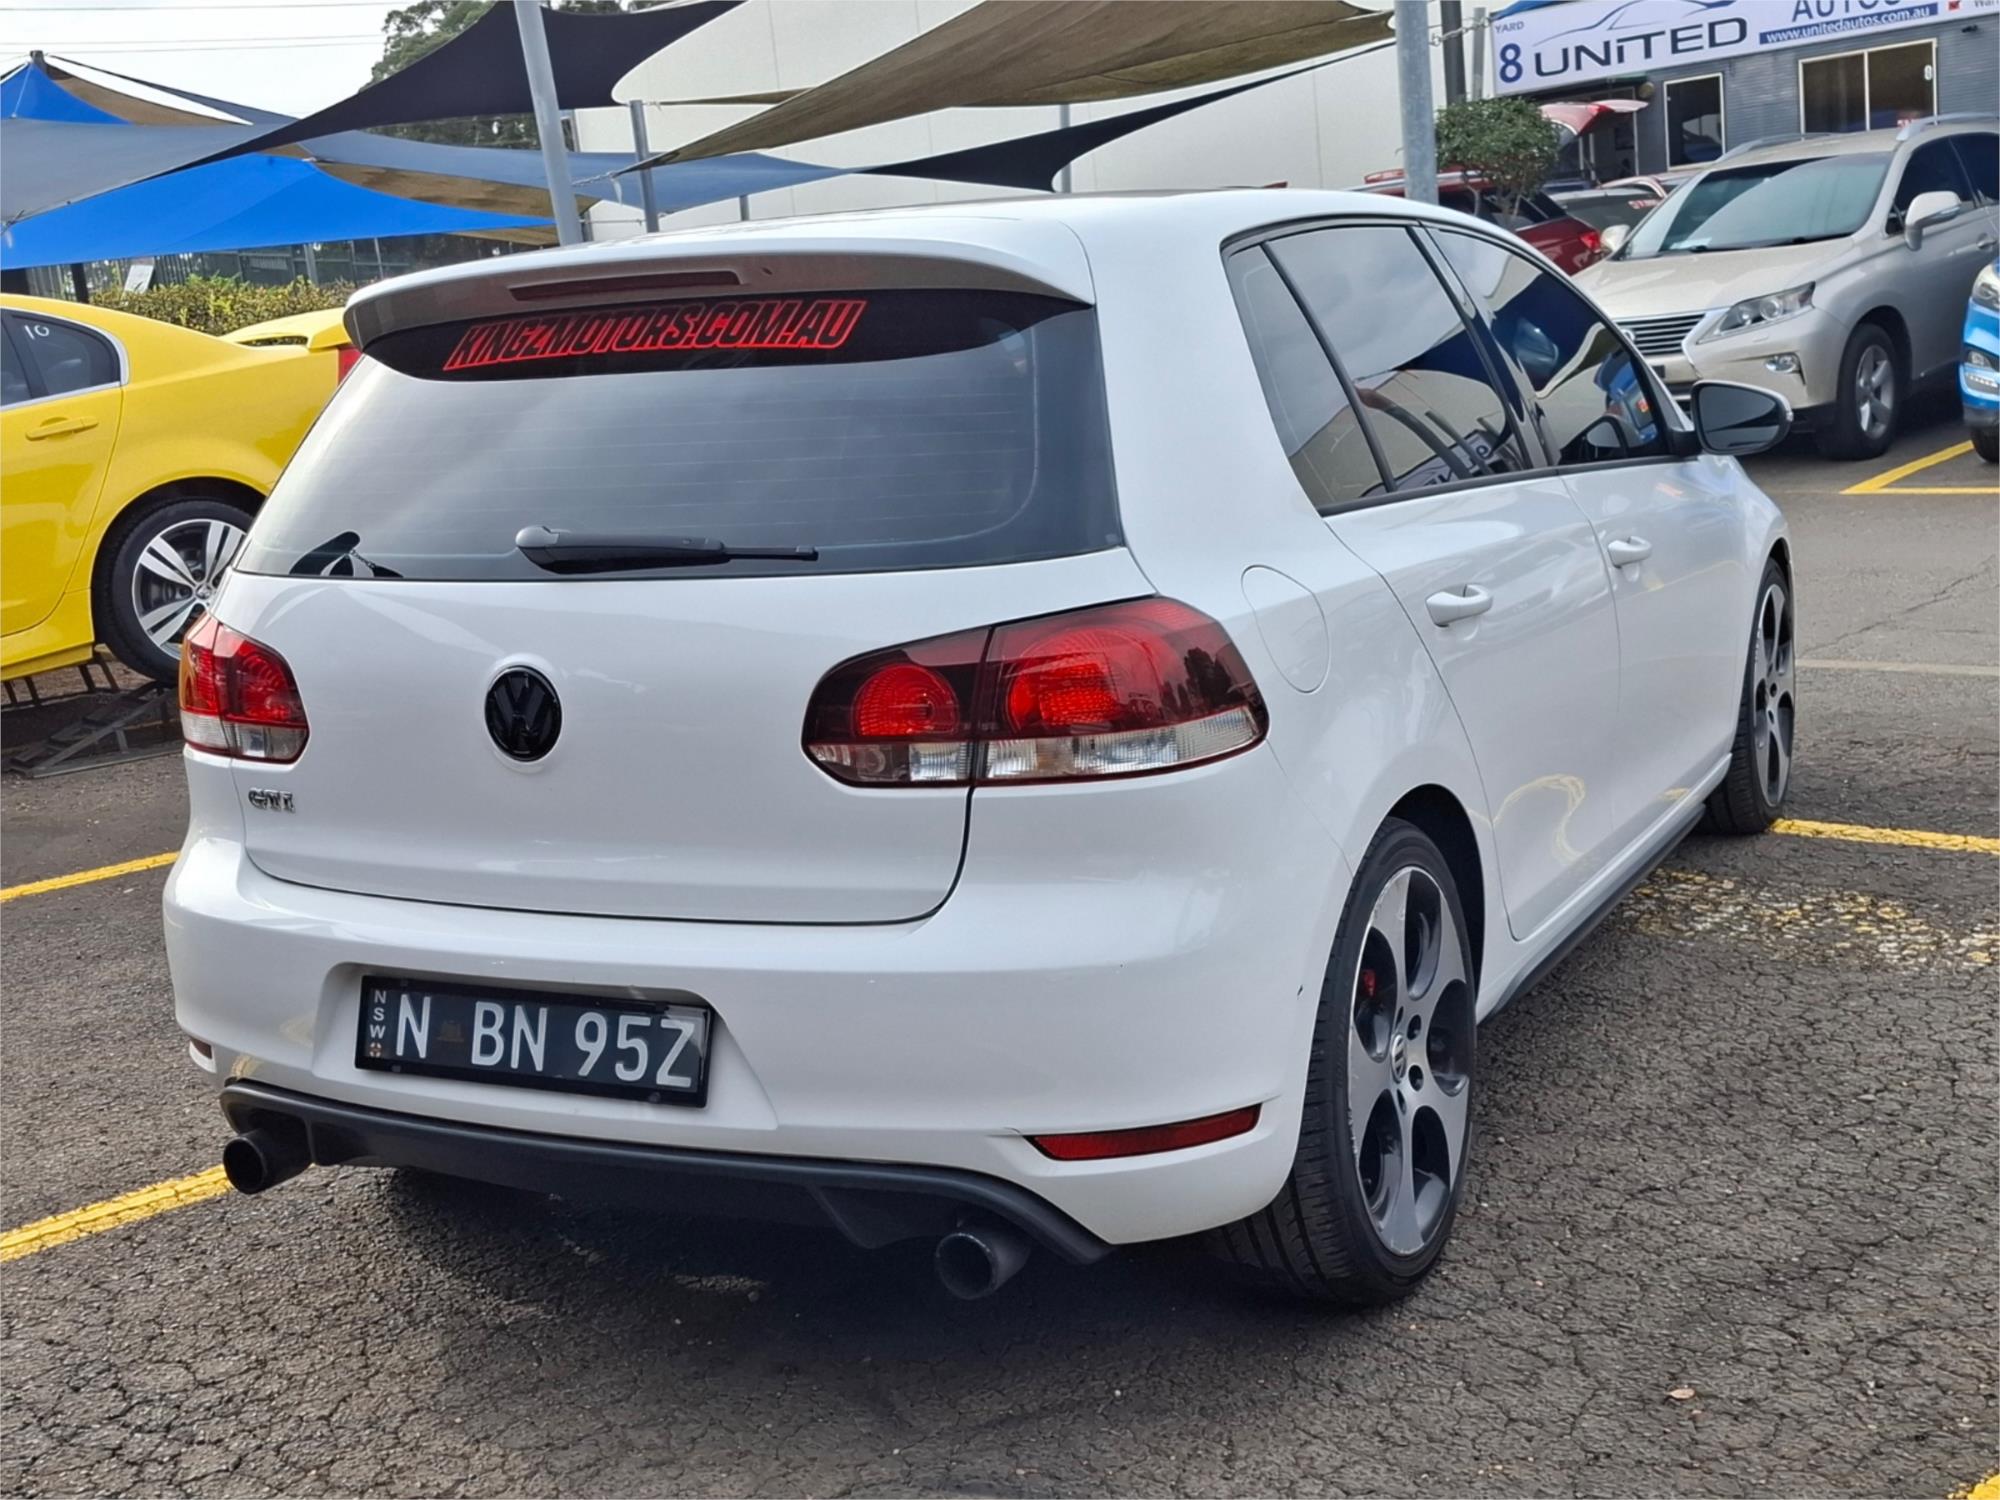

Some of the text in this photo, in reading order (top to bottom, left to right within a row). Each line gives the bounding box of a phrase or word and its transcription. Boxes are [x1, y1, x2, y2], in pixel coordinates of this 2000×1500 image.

[1495, 20, 1525, 34] YARD
[1766, 5, 1931, 43] www.unitedautos.com.au
[1499, 43, 1523, 83] 8
[443, 299, 867, 371] KINGZMOTORS.COM.AU
[248, 788, 296, 813] GTI
[369, 989, 387, 1040] NSW
[395, 993, 696, 1088] N BN 95Z
